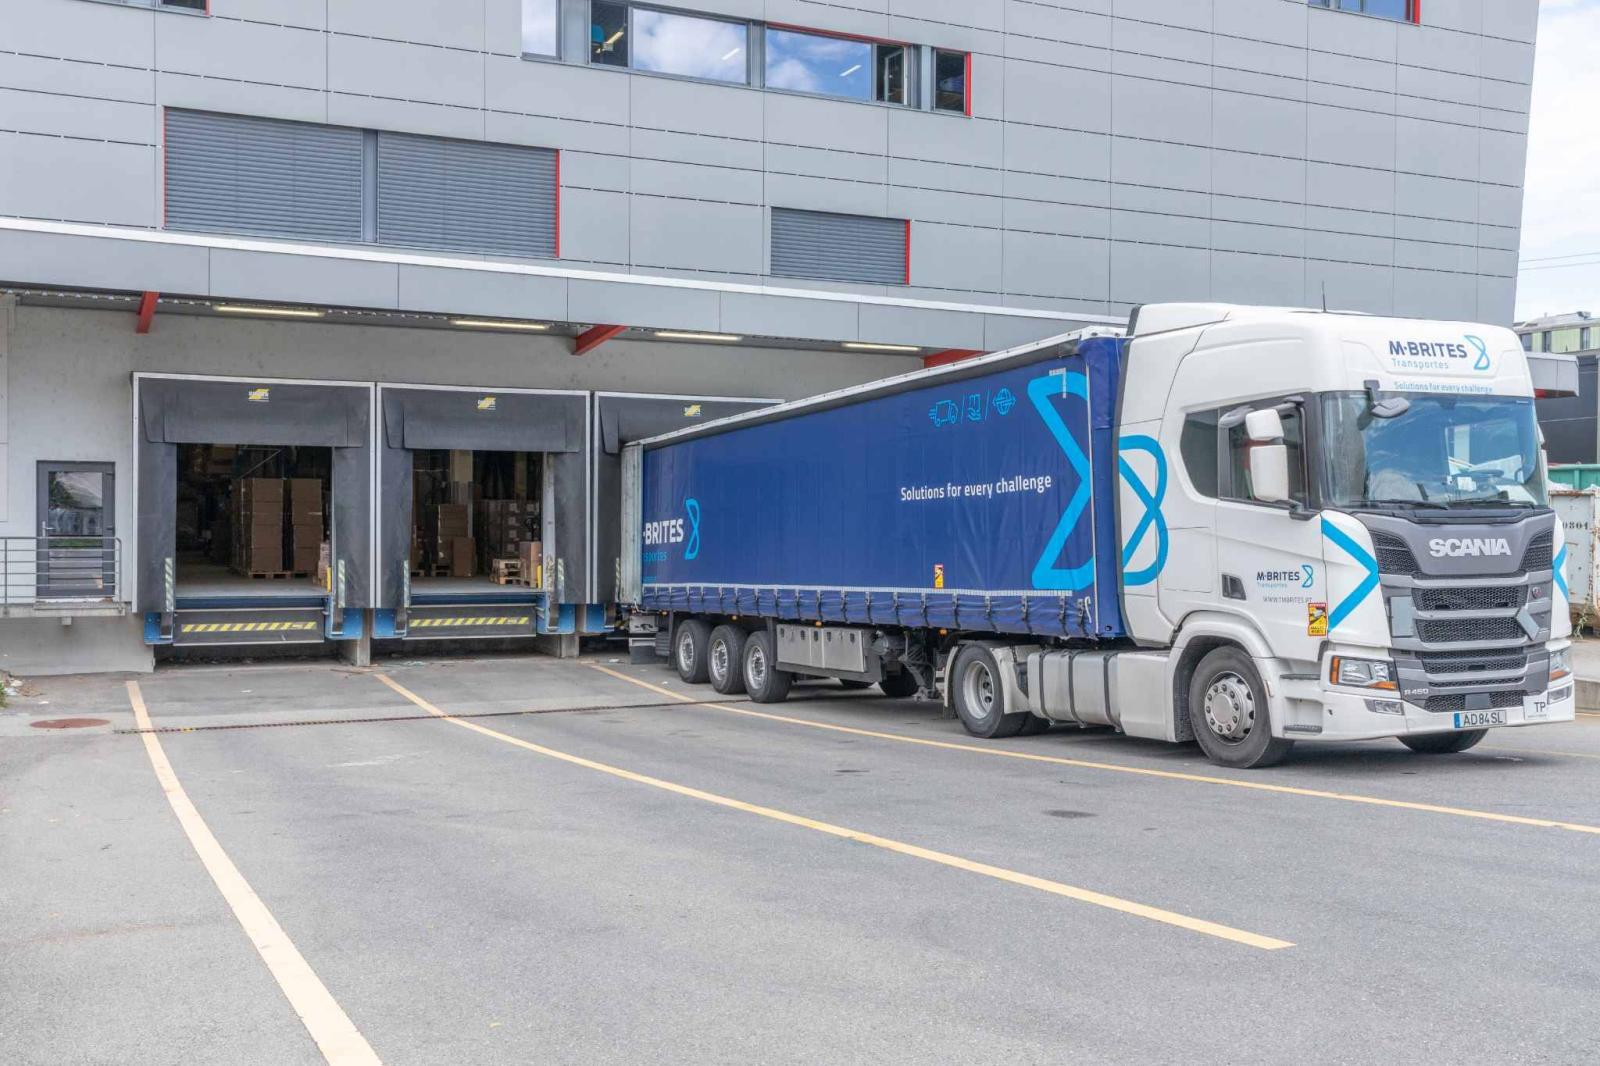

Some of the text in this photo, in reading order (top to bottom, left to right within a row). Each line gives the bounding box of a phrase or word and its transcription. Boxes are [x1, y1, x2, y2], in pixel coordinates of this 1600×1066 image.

[1392, 358, 1449, 370] Transportes
[1394, 381, 1428, 391] Solutions
[1461, 384, 1492, 393] challenge
[901, 475, 1052, 501] Solutions for every challenge
[1429, 538, 1512, 557] SCANIA
[1534, 701, 1546, 713] TP
[1464, 711, 1503, 726] AD 84 SL
